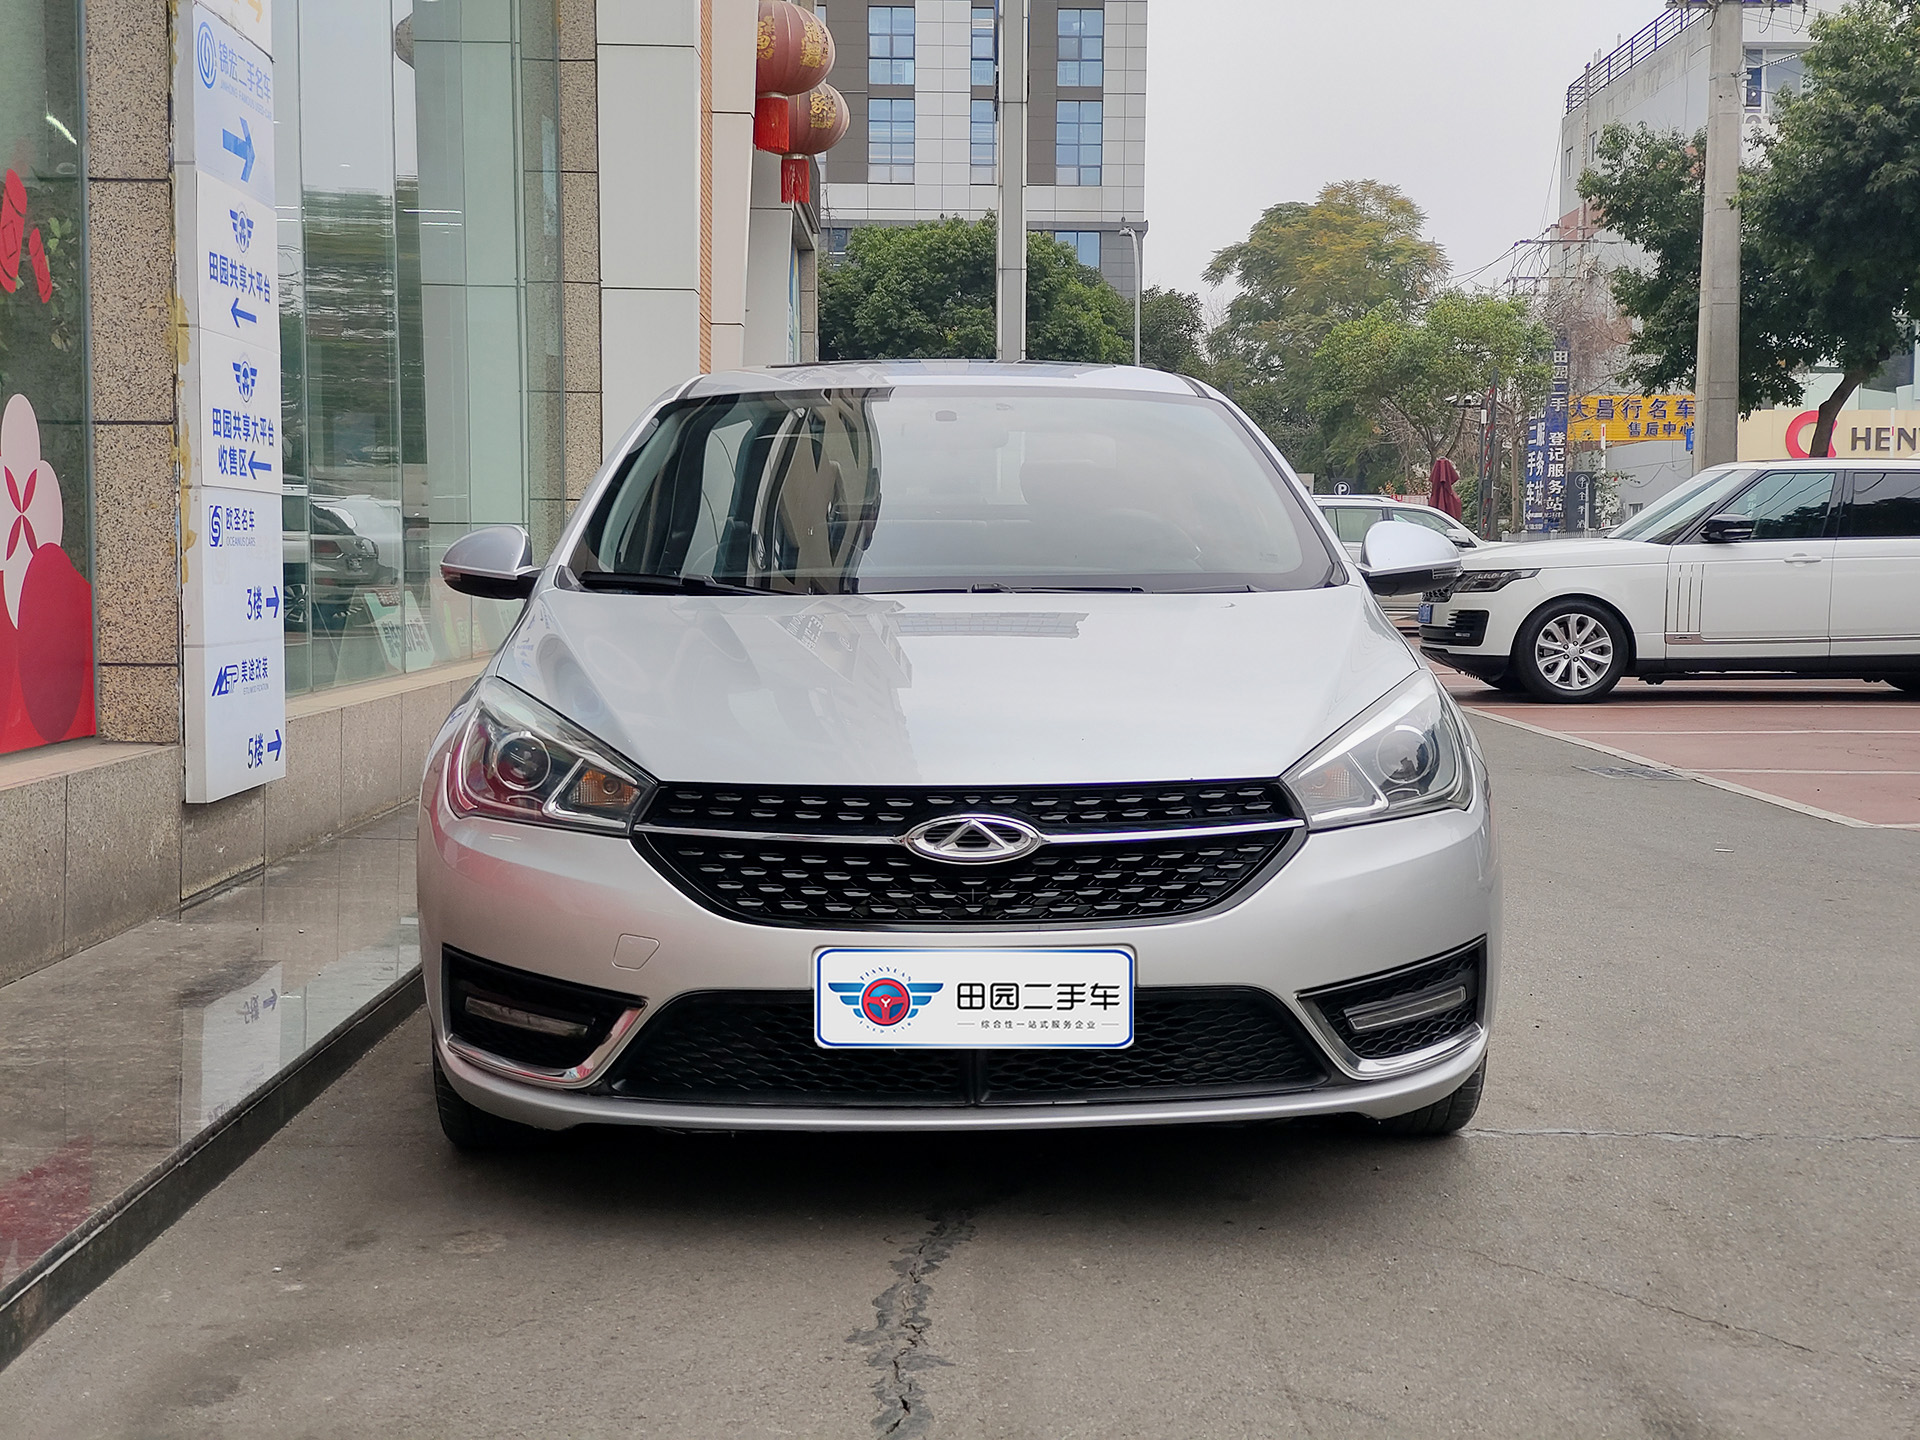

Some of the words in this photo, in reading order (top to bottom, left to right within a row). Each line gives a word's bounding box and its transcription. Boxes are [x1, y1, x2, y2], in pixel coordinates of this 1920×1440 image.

[219, 40, 271, 103] 锦宏二手名车
[209, 251, 270, 304] 田园共享大平台
[1571, 398, 1694, 420] 大昌行名车
[212, 408, 274, 448] 田园共享大平台
[1851, 427, 1920, 451] HEN
[218, 444, 247, 477] 收售区
[1545, 432, 1566, 511] 登记服务站
[226, 507, 255, 531] 欧圣名车
[246, 586, 263, 620] 3楼
[241, 656, 268, 683] 美途改装
[247, 733, 264, 769] 5楼
